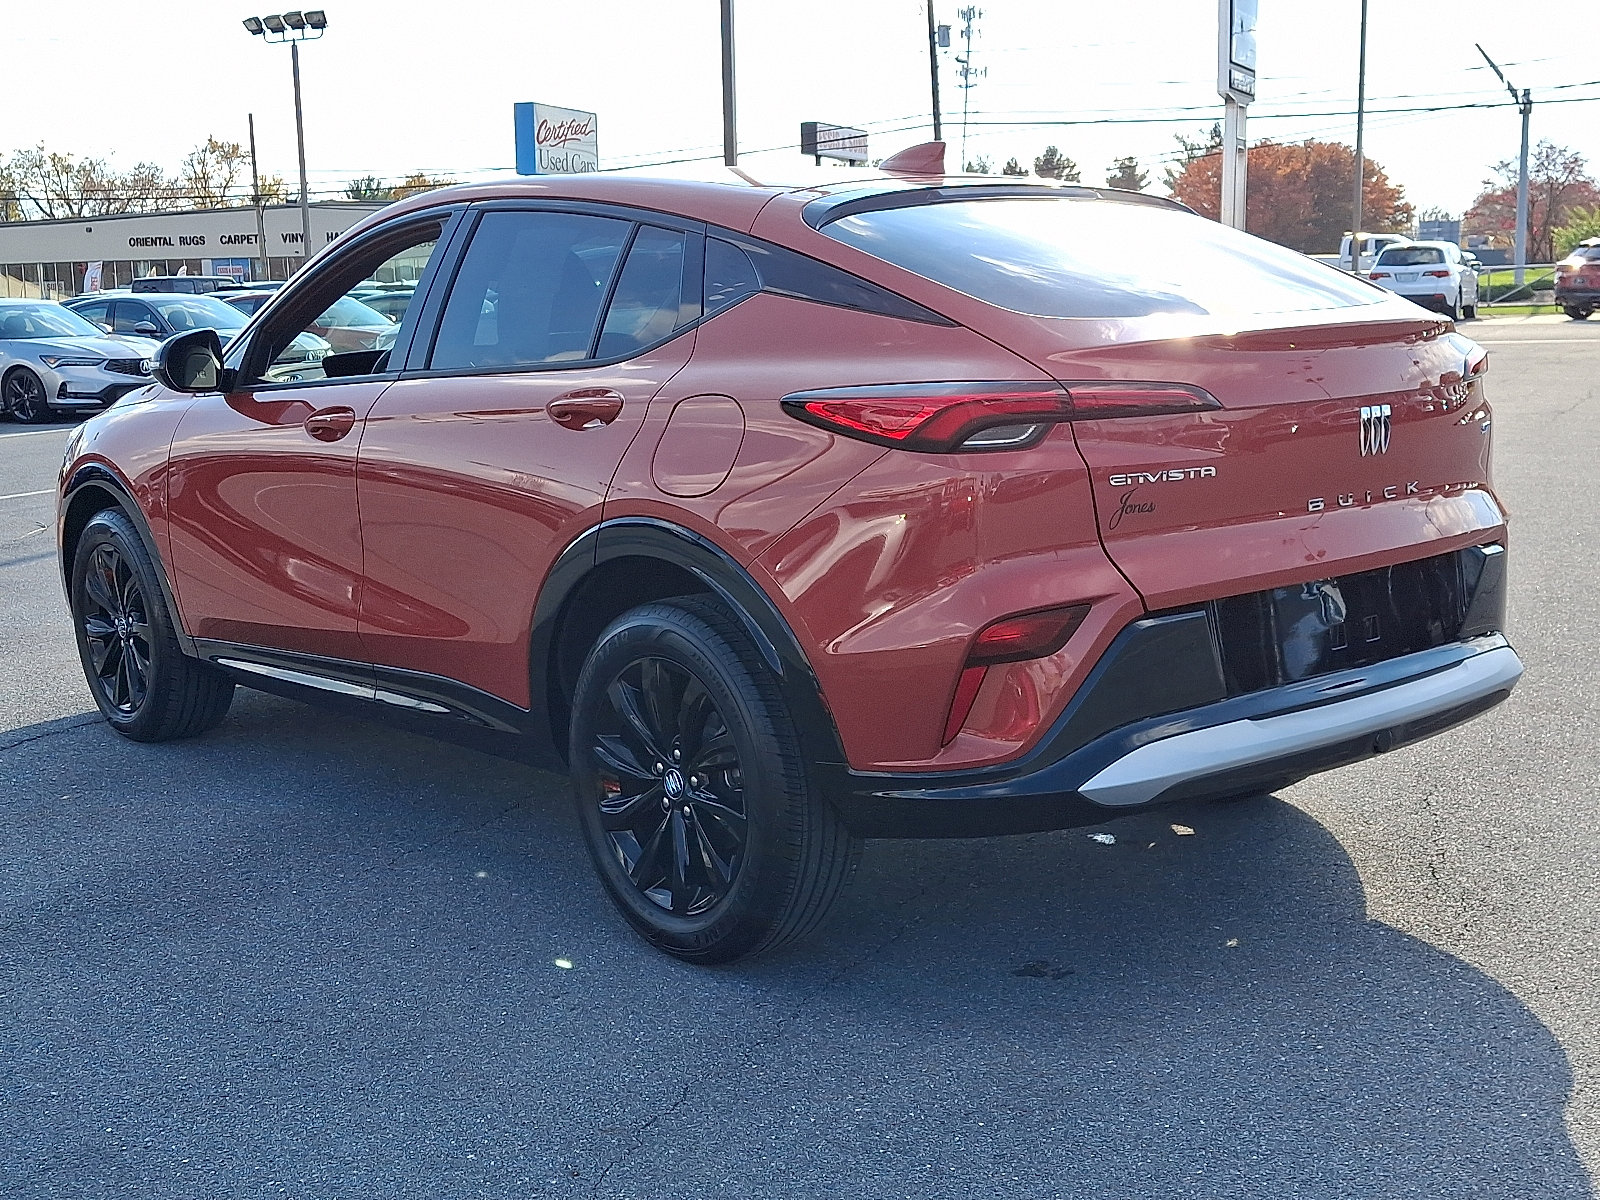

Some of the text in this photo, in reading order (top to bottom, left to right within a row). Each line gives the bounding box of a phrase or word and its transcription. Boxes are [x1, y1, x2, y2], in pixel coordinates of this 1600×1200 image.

[536, 117, 596, 148] Certified
[540, 149, 596, 174] Used Cars
[128, 236, 174, 247] ORIENTAL
[179, 235, 206, 246] RUGS
[219, 233, 259, 245] CARPET
[1109, 466, 1217, 486] ENVISTA
[1108, 487, 1156, 530] Jones
[1307, 480, 1420, 512] BUICK
